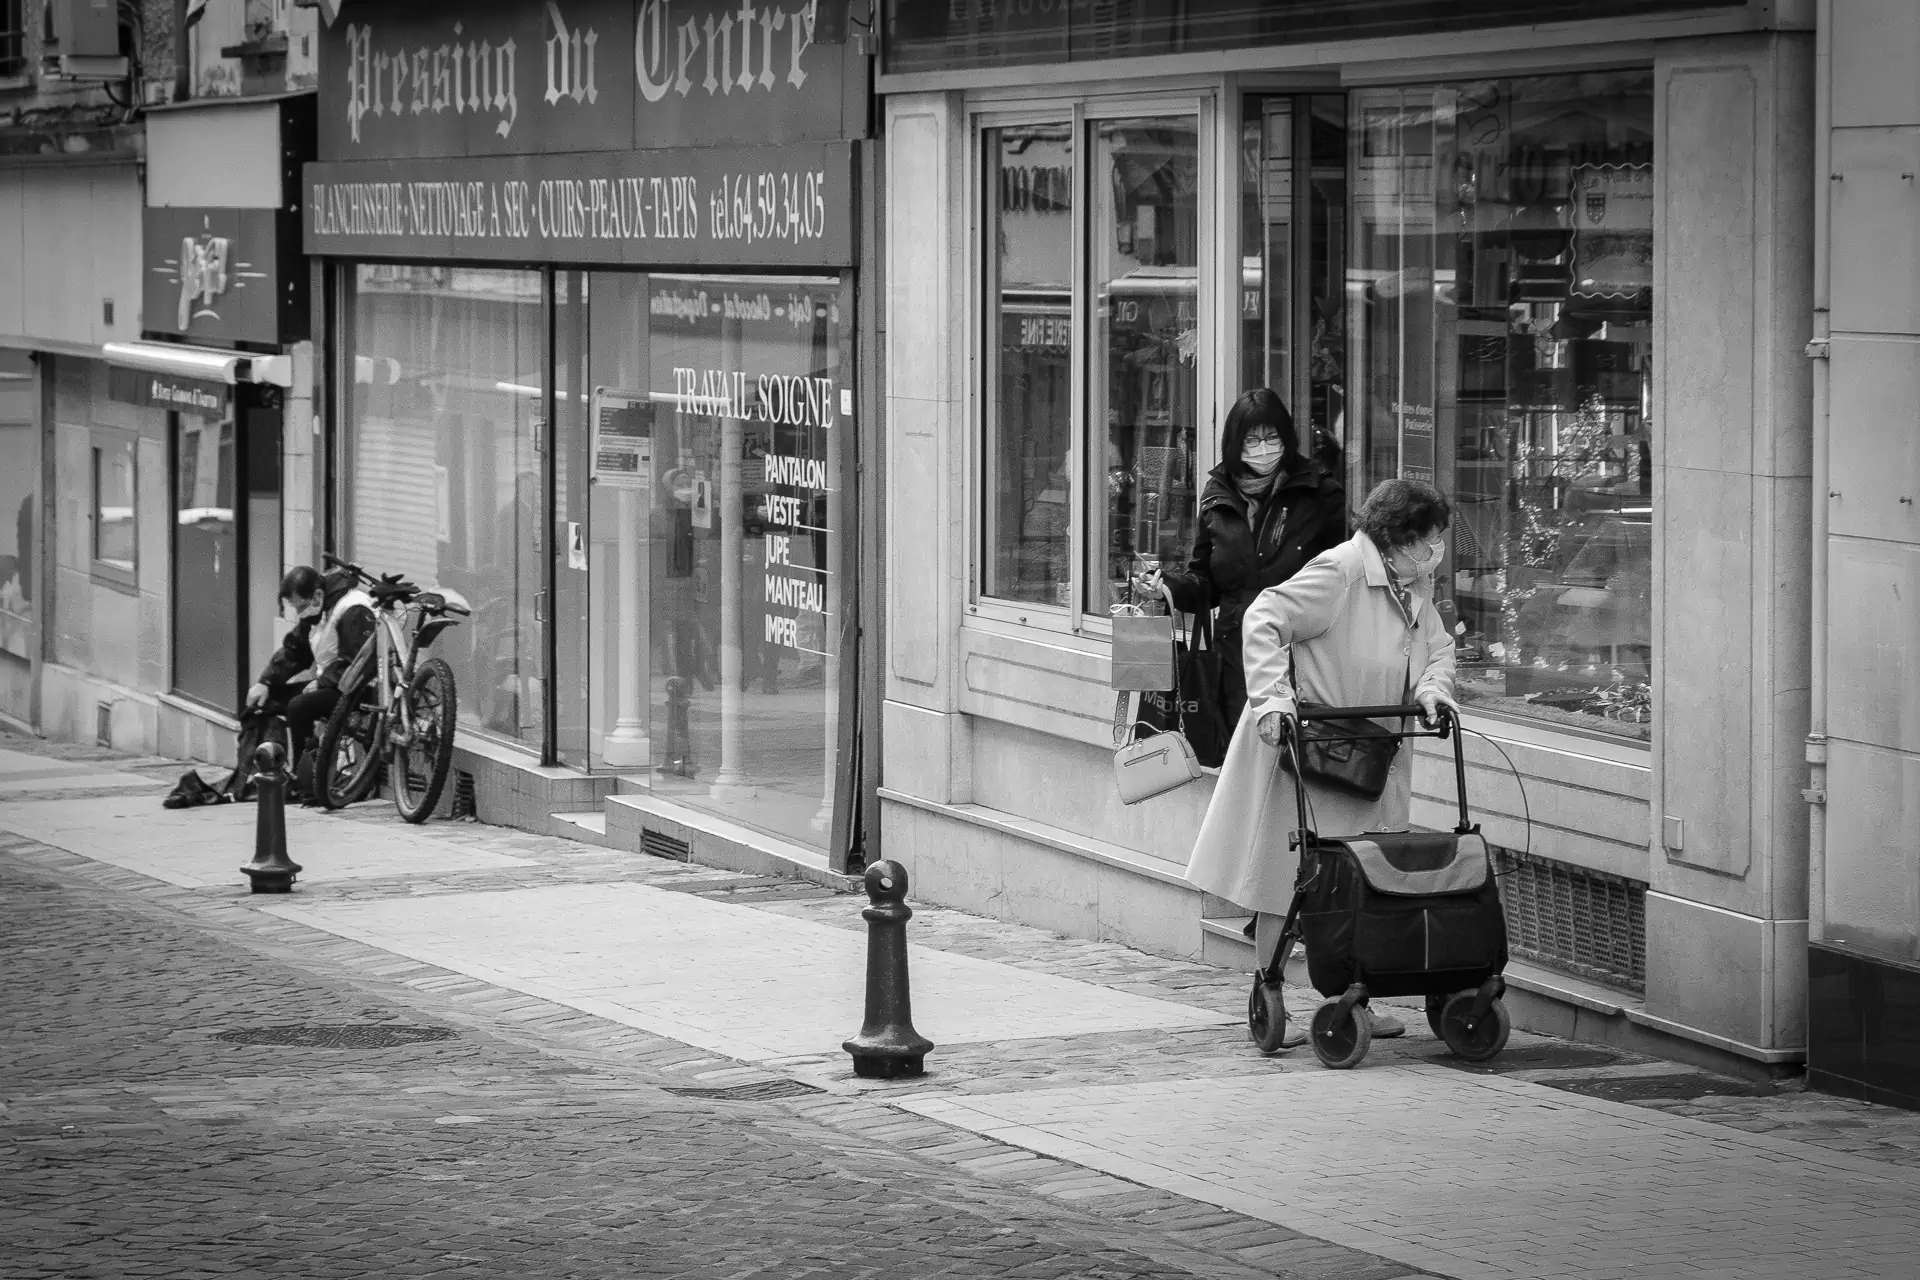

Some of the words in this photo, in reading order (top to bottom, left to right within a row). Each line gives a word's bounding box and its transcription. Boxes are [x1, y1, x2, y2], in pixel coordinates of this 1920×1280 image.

[347, 21, 517, 143] Pressing
[543, 0, 599, 106] du
[635, 0, 815, 102] Centre
[673, 367, 751, 421] TRAVAIL
[758, 373, 834, 429] SOIGNE
[765, 454, 826, 491] PANTALON
[765, 494, 801, 528] VESTE
[764, 533, 790, 570] JUPE
[765, 574, 823, 613] MANTEAU
[765, 613, 798, 649] IMPER
